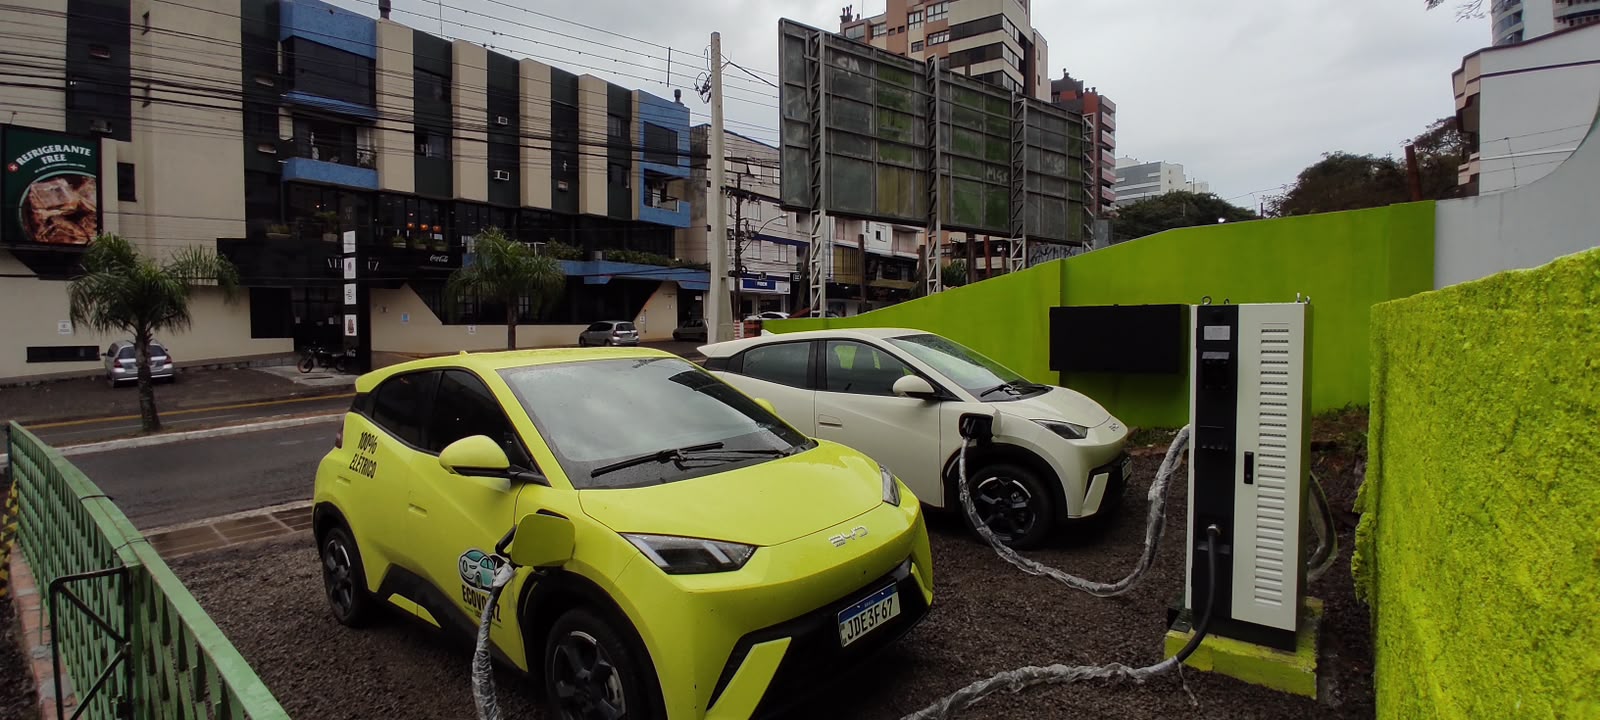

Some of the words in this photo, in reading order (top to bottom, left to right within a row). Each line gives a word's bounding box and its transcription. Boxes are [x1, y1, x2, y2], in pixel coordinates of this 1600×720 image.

[15, 144, 91, 166] REFRIGERANTE
[41, 154, 67, 164] FREE
[358, 431, 379, 455] 100%
[349, 452, 377, 479] ELÉTRICO
[829, 525, 868, 548] BYD
[461, 584, 502, 623] ECOVOZ
[847, 597, 893, 641] JDE3F67
